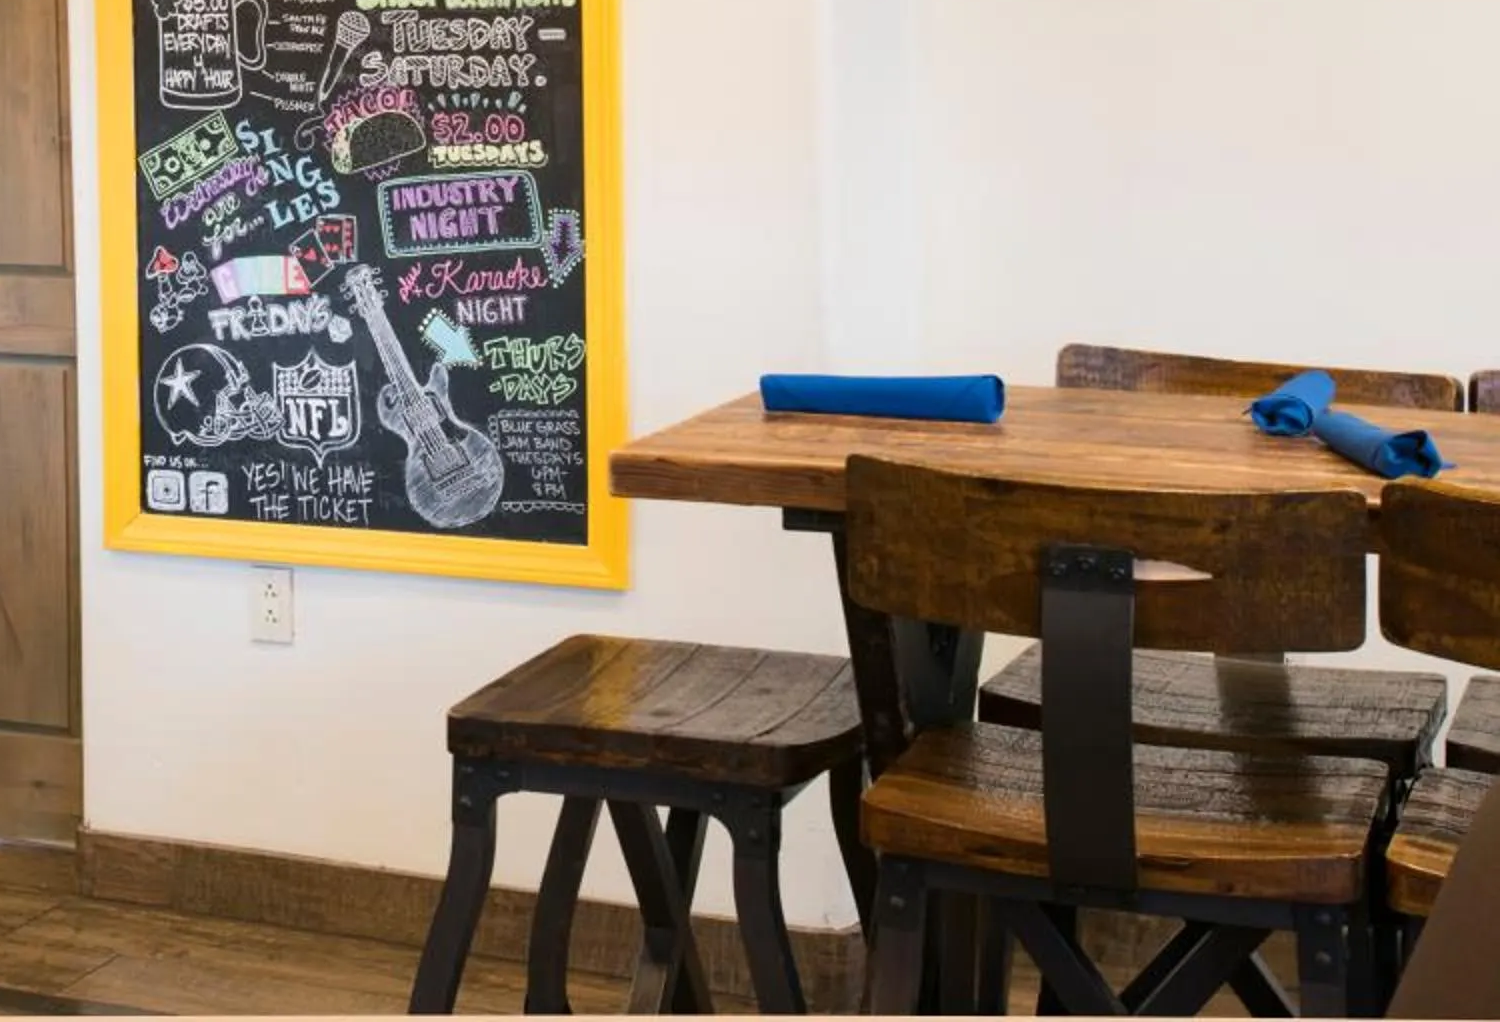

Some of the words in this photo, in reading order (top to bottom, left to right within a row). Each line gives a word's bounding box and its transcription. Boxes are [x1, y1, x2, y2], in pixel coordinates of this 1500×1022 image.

[177, 13, 229, 31] DRAFTS
[381, 9, 534, 52] TUESDAY
[163, 31, 231, 58] EVERYDAY
[165, 67, 197, 91] HAPPY
[204, 67, 236, 90] HOUR
[431, 112, 525, 144] $2.00
[428, 139, 548, 168] TUESDAYS
[391, 177, 520, 211] INDUSTRY
[409, 204, 504, 241] NIGHT
[425, 256, 549, 299] Karaoke
[455, 295, 528, 324] NIGHT
[483, 332, 585, 375] THURS
[285, 398, 350, 440] NFL
[500, 419, 533, 434] BLUE
[535, 420, 580, 436] GRASS
[502, 435, 530, 450] JAM
[533, 437, 573, 451] BAND
[506, 451, 584, 465] TUESDAYS
[241, 459, 287, 491] YES!
[292, 466, 322, 495] WE
[327, 465, 376, 495] HAVE
[249, 494, 290, 521] THE
[298, 495, 374, 525] TICKET
